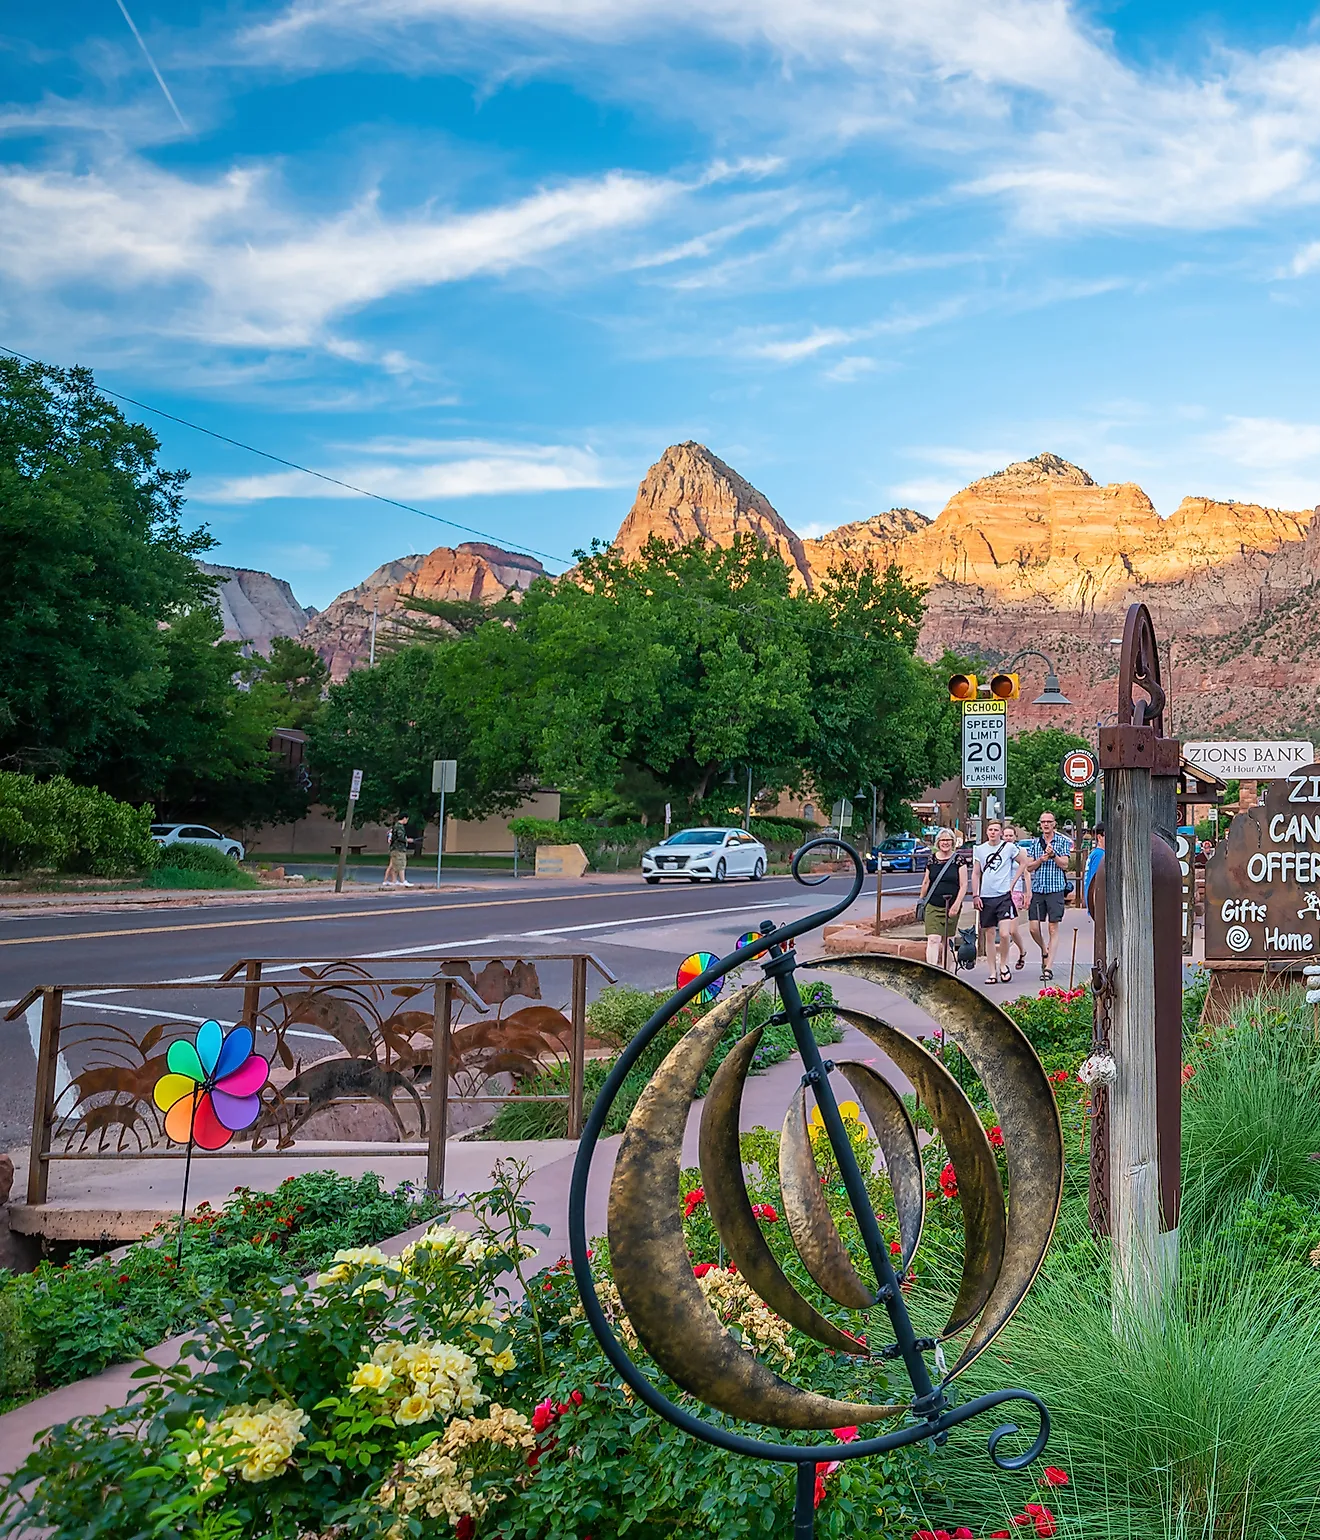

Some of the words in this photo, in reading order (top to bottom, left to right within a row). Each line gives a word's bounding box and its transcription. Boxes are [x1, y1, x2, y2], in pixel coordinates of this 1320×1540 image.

[966, 703, 1004, 712] SCHOOL
[967, 720, 1003, 729] SPEED
[970, 731, 999, 740] LIMIT
[967, 742, 1002, 762] 20
[1189, 748, 1247, 762] ZIONS
[1253, 747, 1306, 762] BANK
[973, 765, 996, 773] WHEN
[1220, 765, 1230, 773] 24
[1233, 765, 1254, 773] Hour
[1256, 765, 1276, 773] ATM
[966, 773, 1003, 782] FLASHING
[1075, 797, 1082, 807] 5
[1221, 898, 1267, 923] Gifts
[1263, 926, 1313, 951] Home
